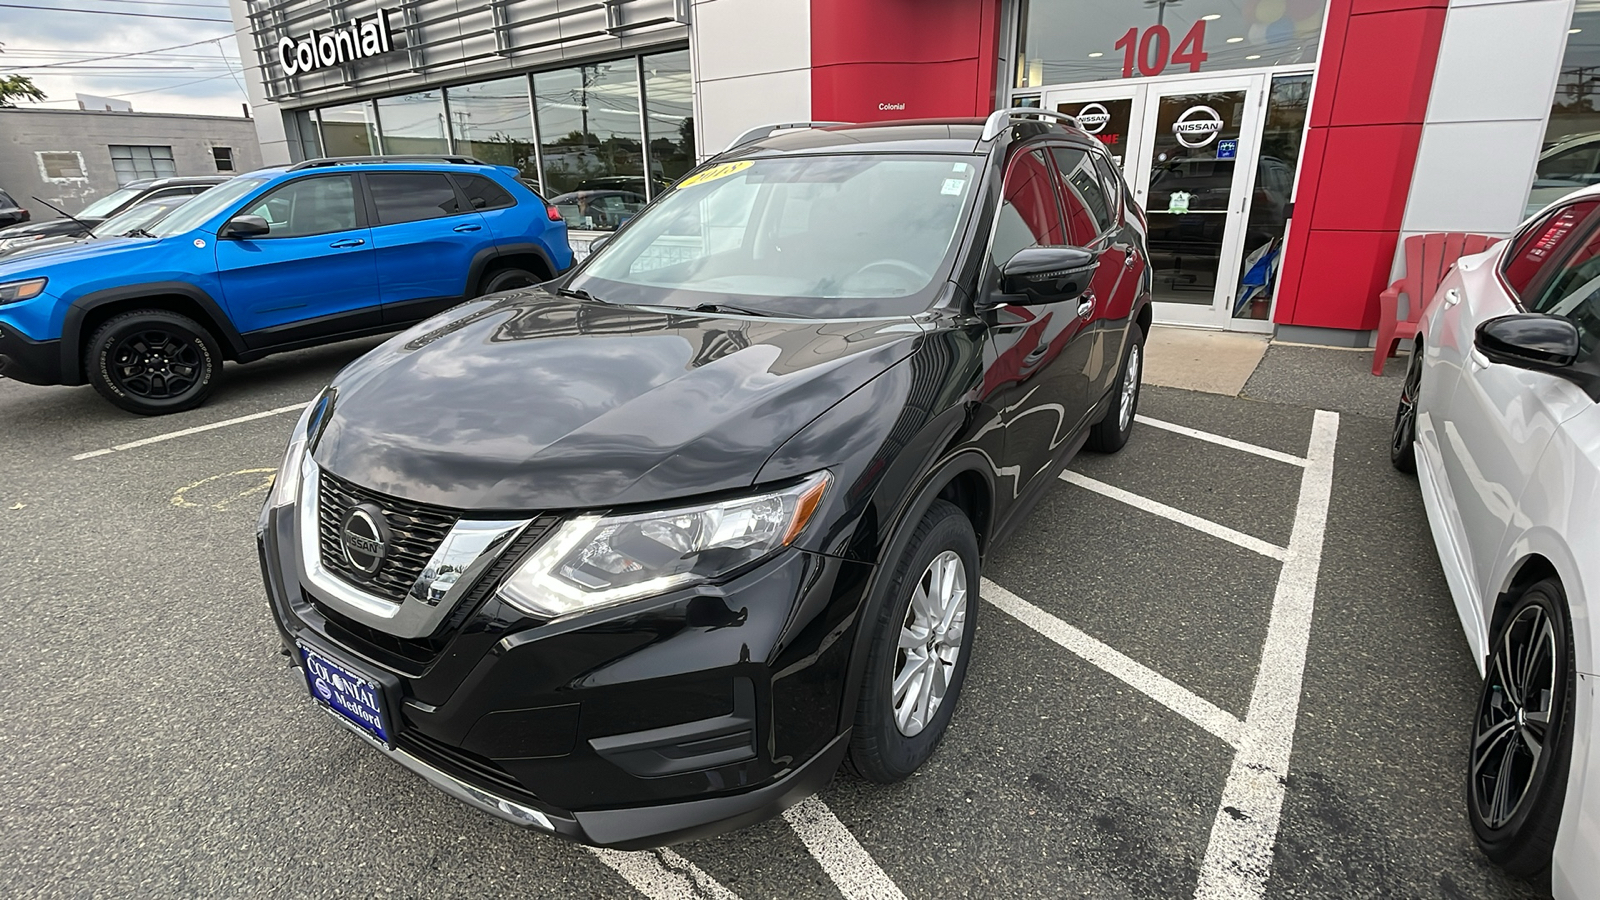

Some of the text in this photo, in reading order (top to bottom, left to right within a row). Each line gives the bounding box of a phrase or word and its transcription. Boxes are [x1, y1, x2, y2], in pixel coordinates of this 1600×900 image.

[278, 7, 389, 76] Colonial
[1114, 19, 1208, 78] 104
[878, 103, 906, 111] Colonial
[1176, 122, 1219, 132] NISSAN
[345, 533, 378, 554] NISSAN
[307, 655, 380, 713] COLONIAL
[334, 690, 382, 730] Medford
